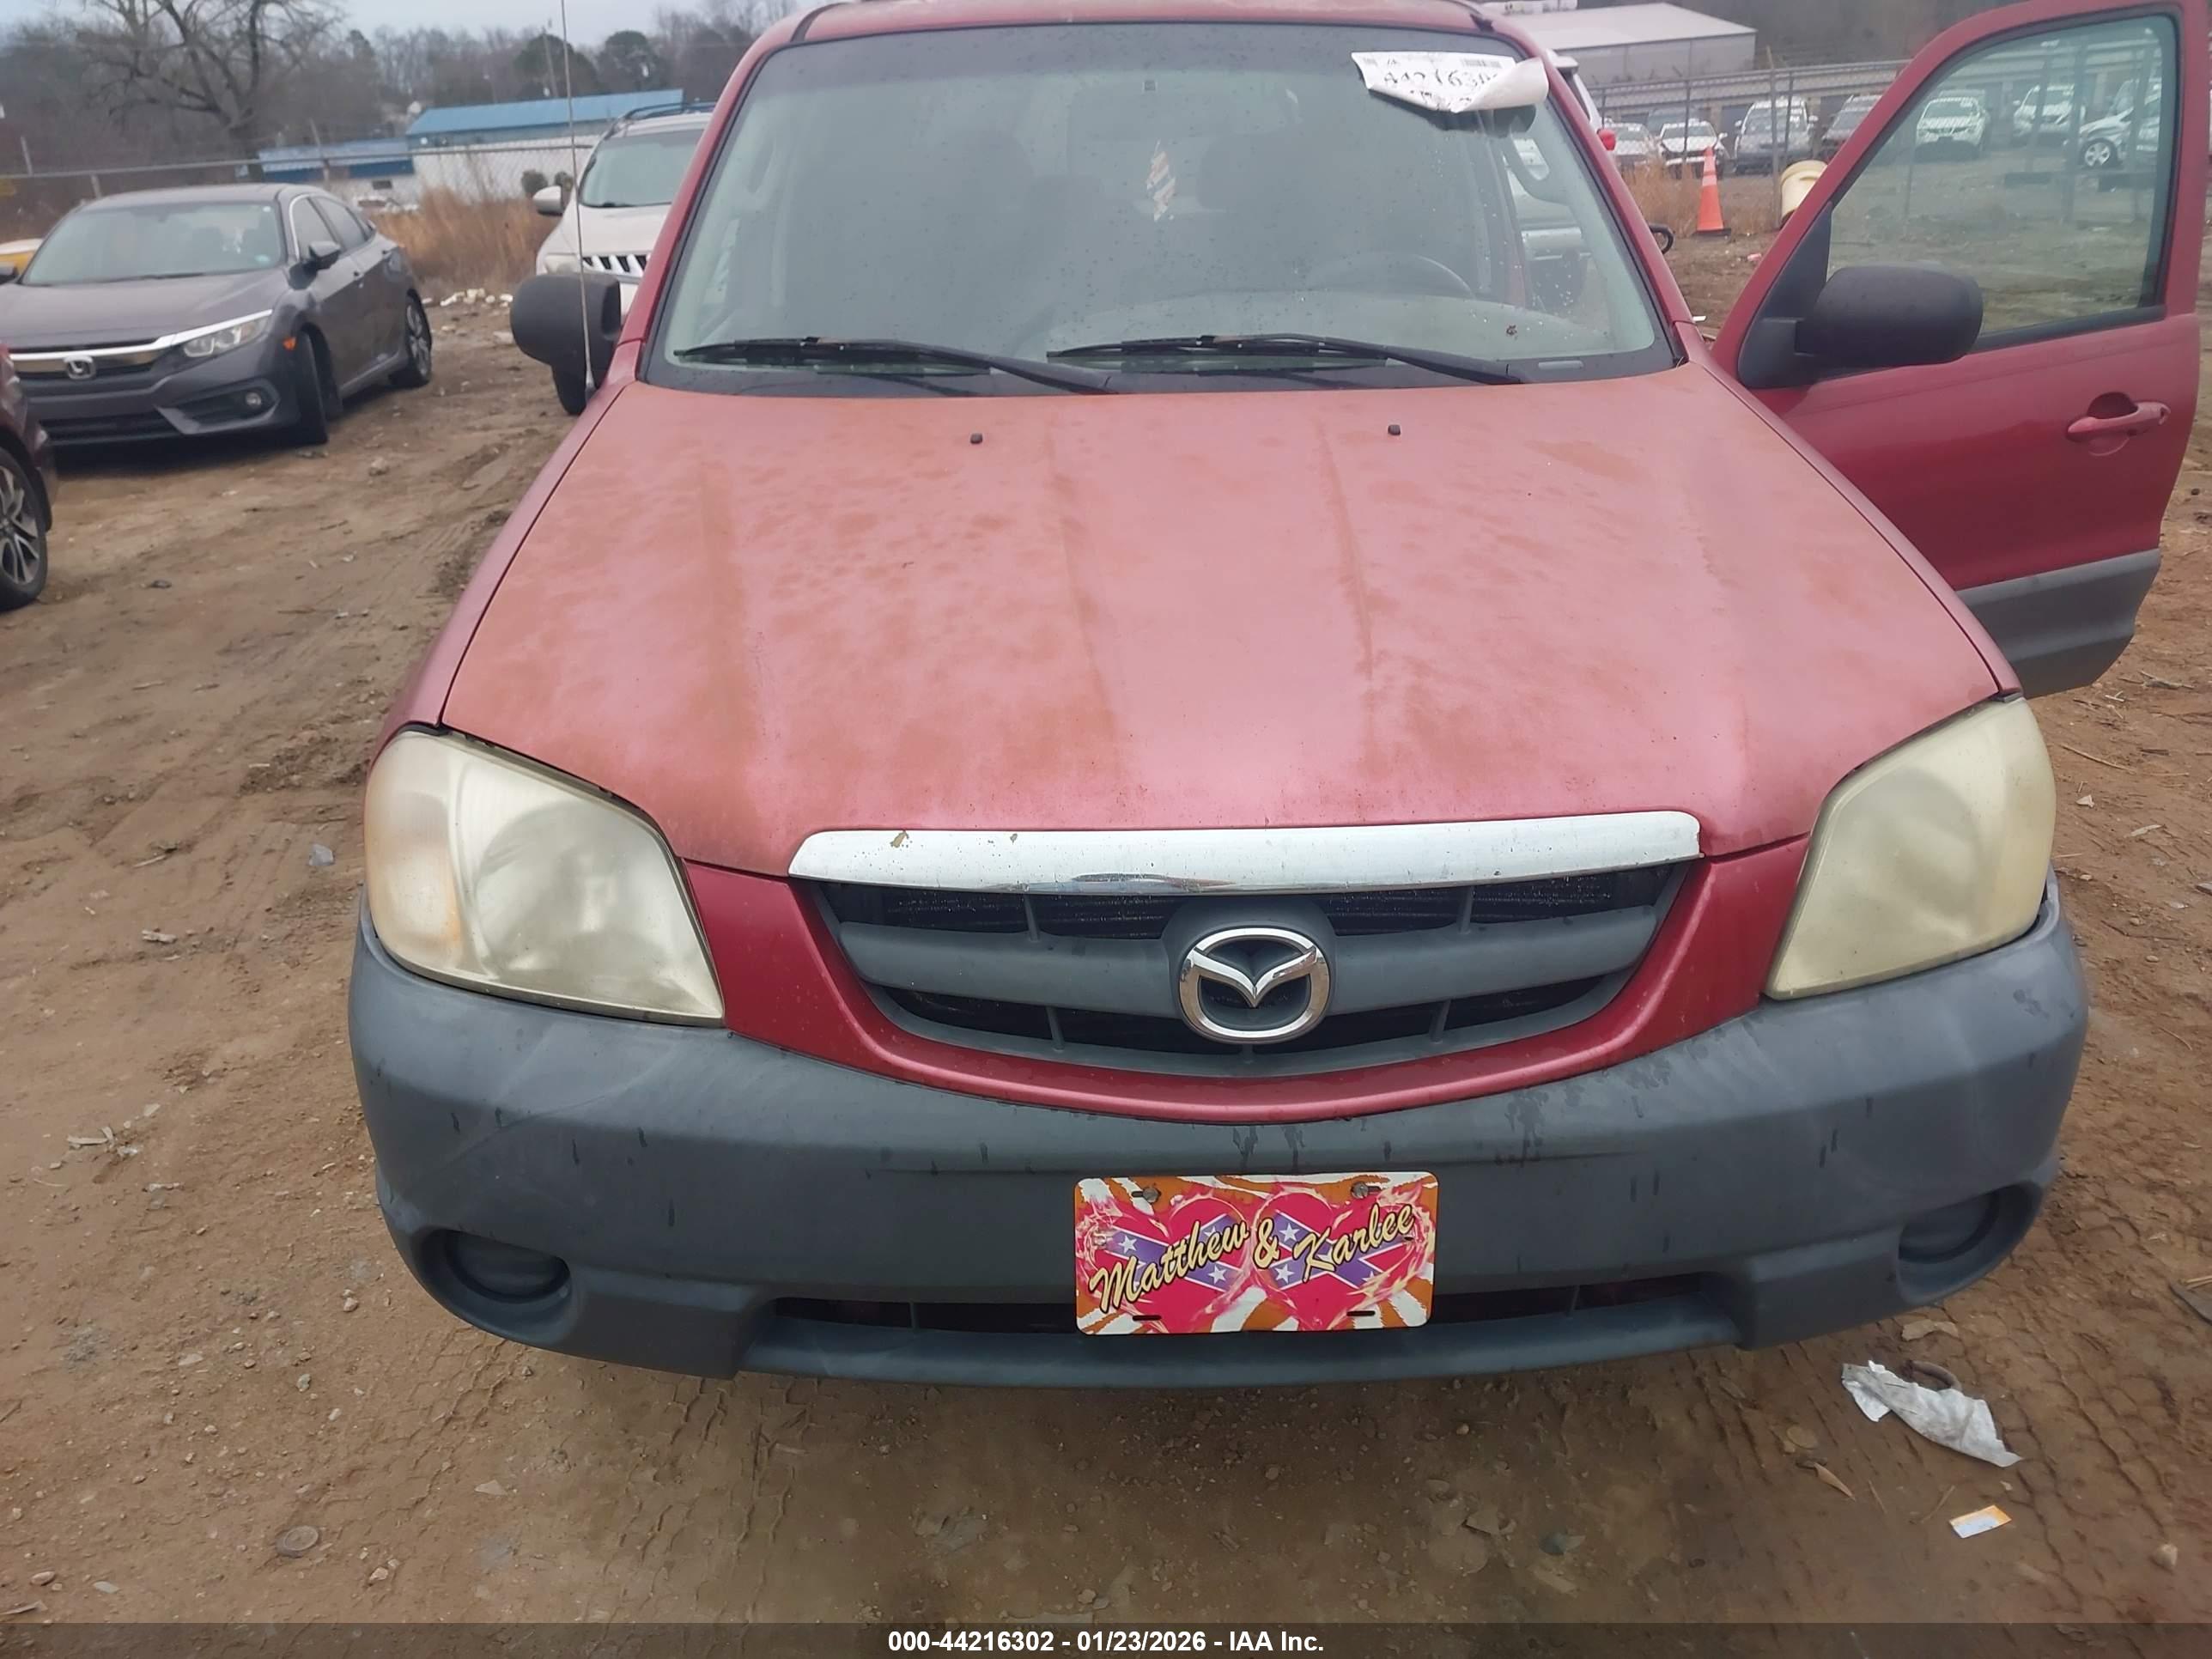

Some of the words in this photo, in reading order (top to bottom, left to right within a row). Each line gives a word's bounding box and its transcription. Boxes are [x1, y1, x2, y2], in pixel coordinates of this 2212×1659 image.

[1088, 1218, 1250, 1313] Matthew
[1253, 1218, 1279, 1270] &
[1294, 1204, 1415, 1282] Karlee
